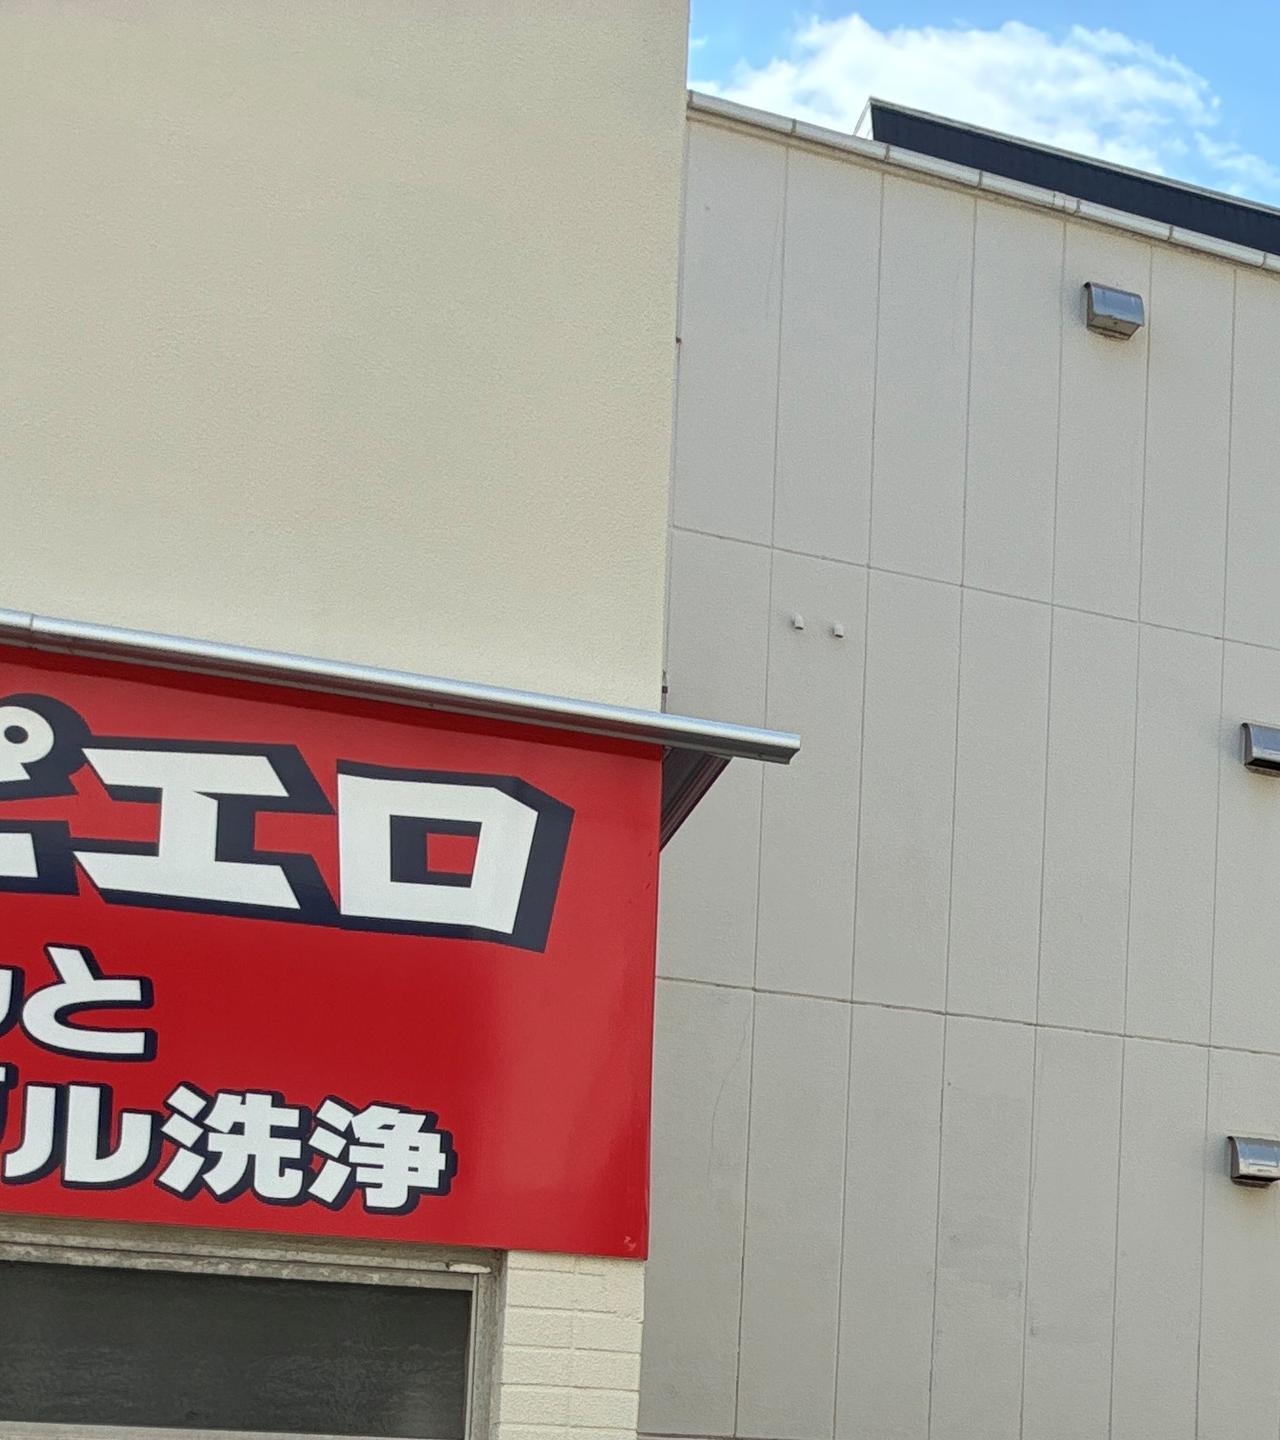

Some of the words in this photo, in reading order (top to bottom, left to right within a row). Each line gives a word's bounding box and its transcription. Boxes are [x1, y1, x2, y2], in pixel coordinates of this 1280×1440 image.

[0, 946, 148, 1056] と
[0, 1068, 450, 1212] ル洗浄
